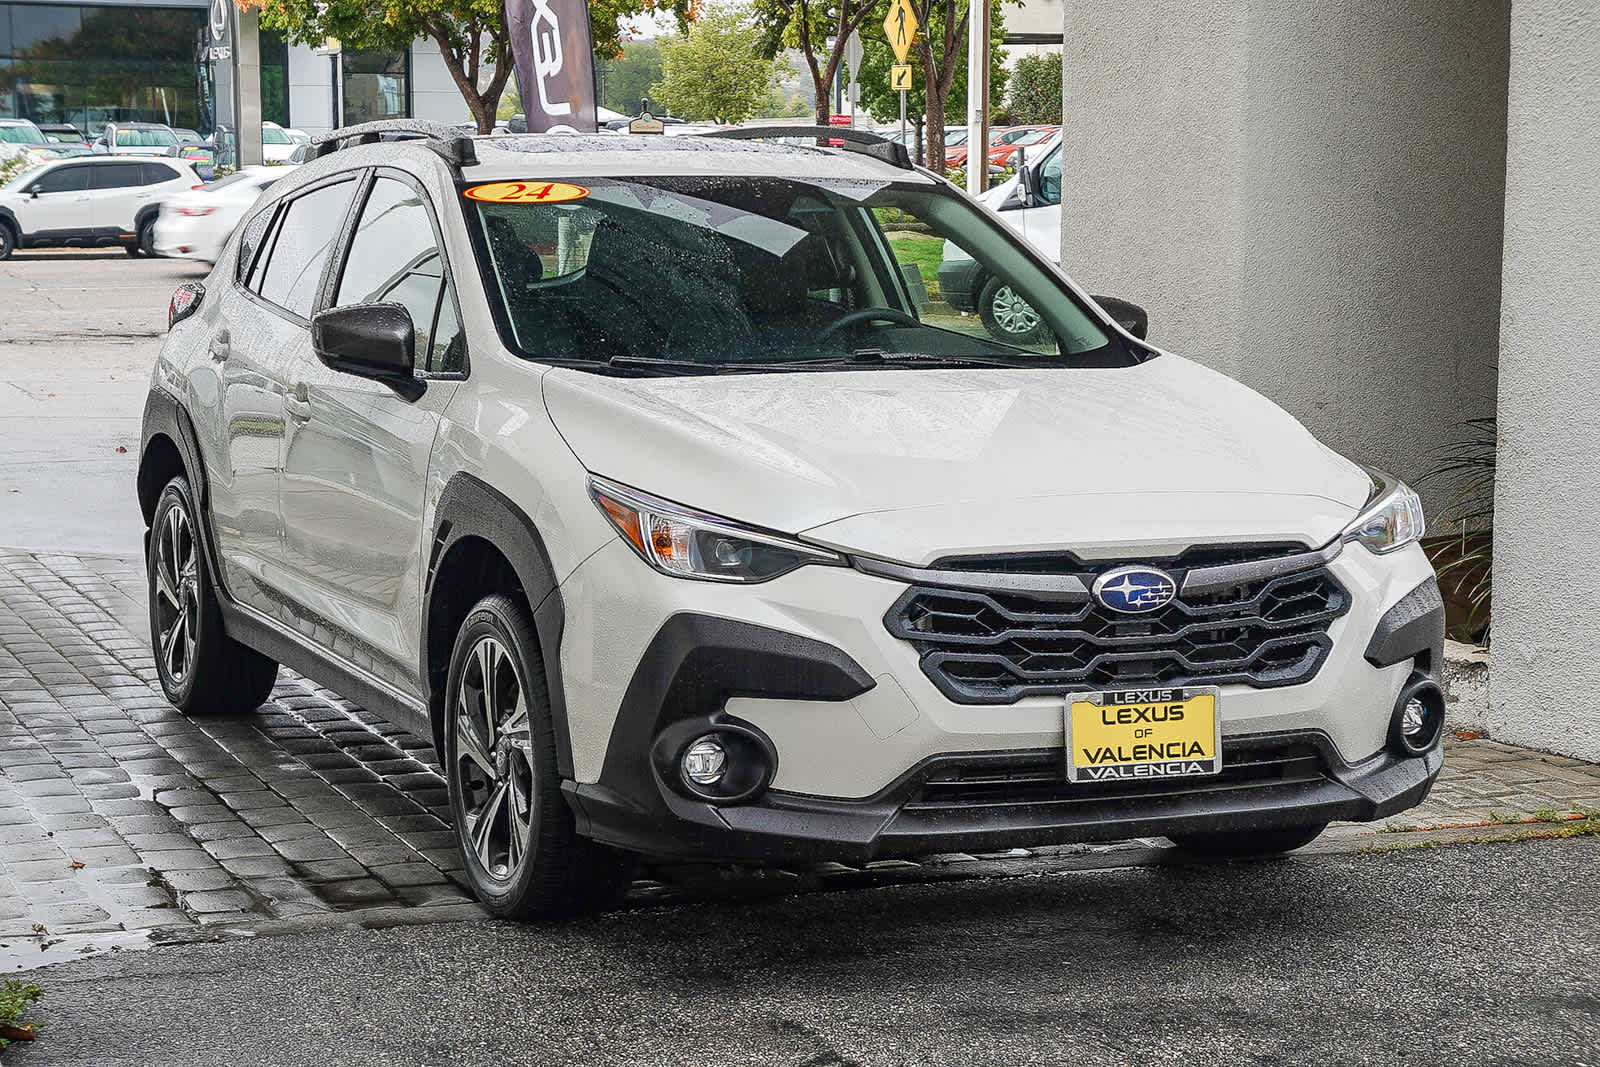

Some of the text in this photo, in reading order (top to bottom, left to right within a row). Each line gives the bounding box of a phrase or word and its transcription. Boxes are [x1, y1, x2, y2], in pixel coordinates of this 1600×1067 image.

[499, 183, 555, 200] 24
[1114, 690, 1173, 703] LEXUS
[1102, 705, 1184, 725] LEXUS
[1134, 729, 1153, 739] OF
[1082, 741, 1205, 764] VALENCIA
[1087, 762, 1204, 779] VALENCIA
